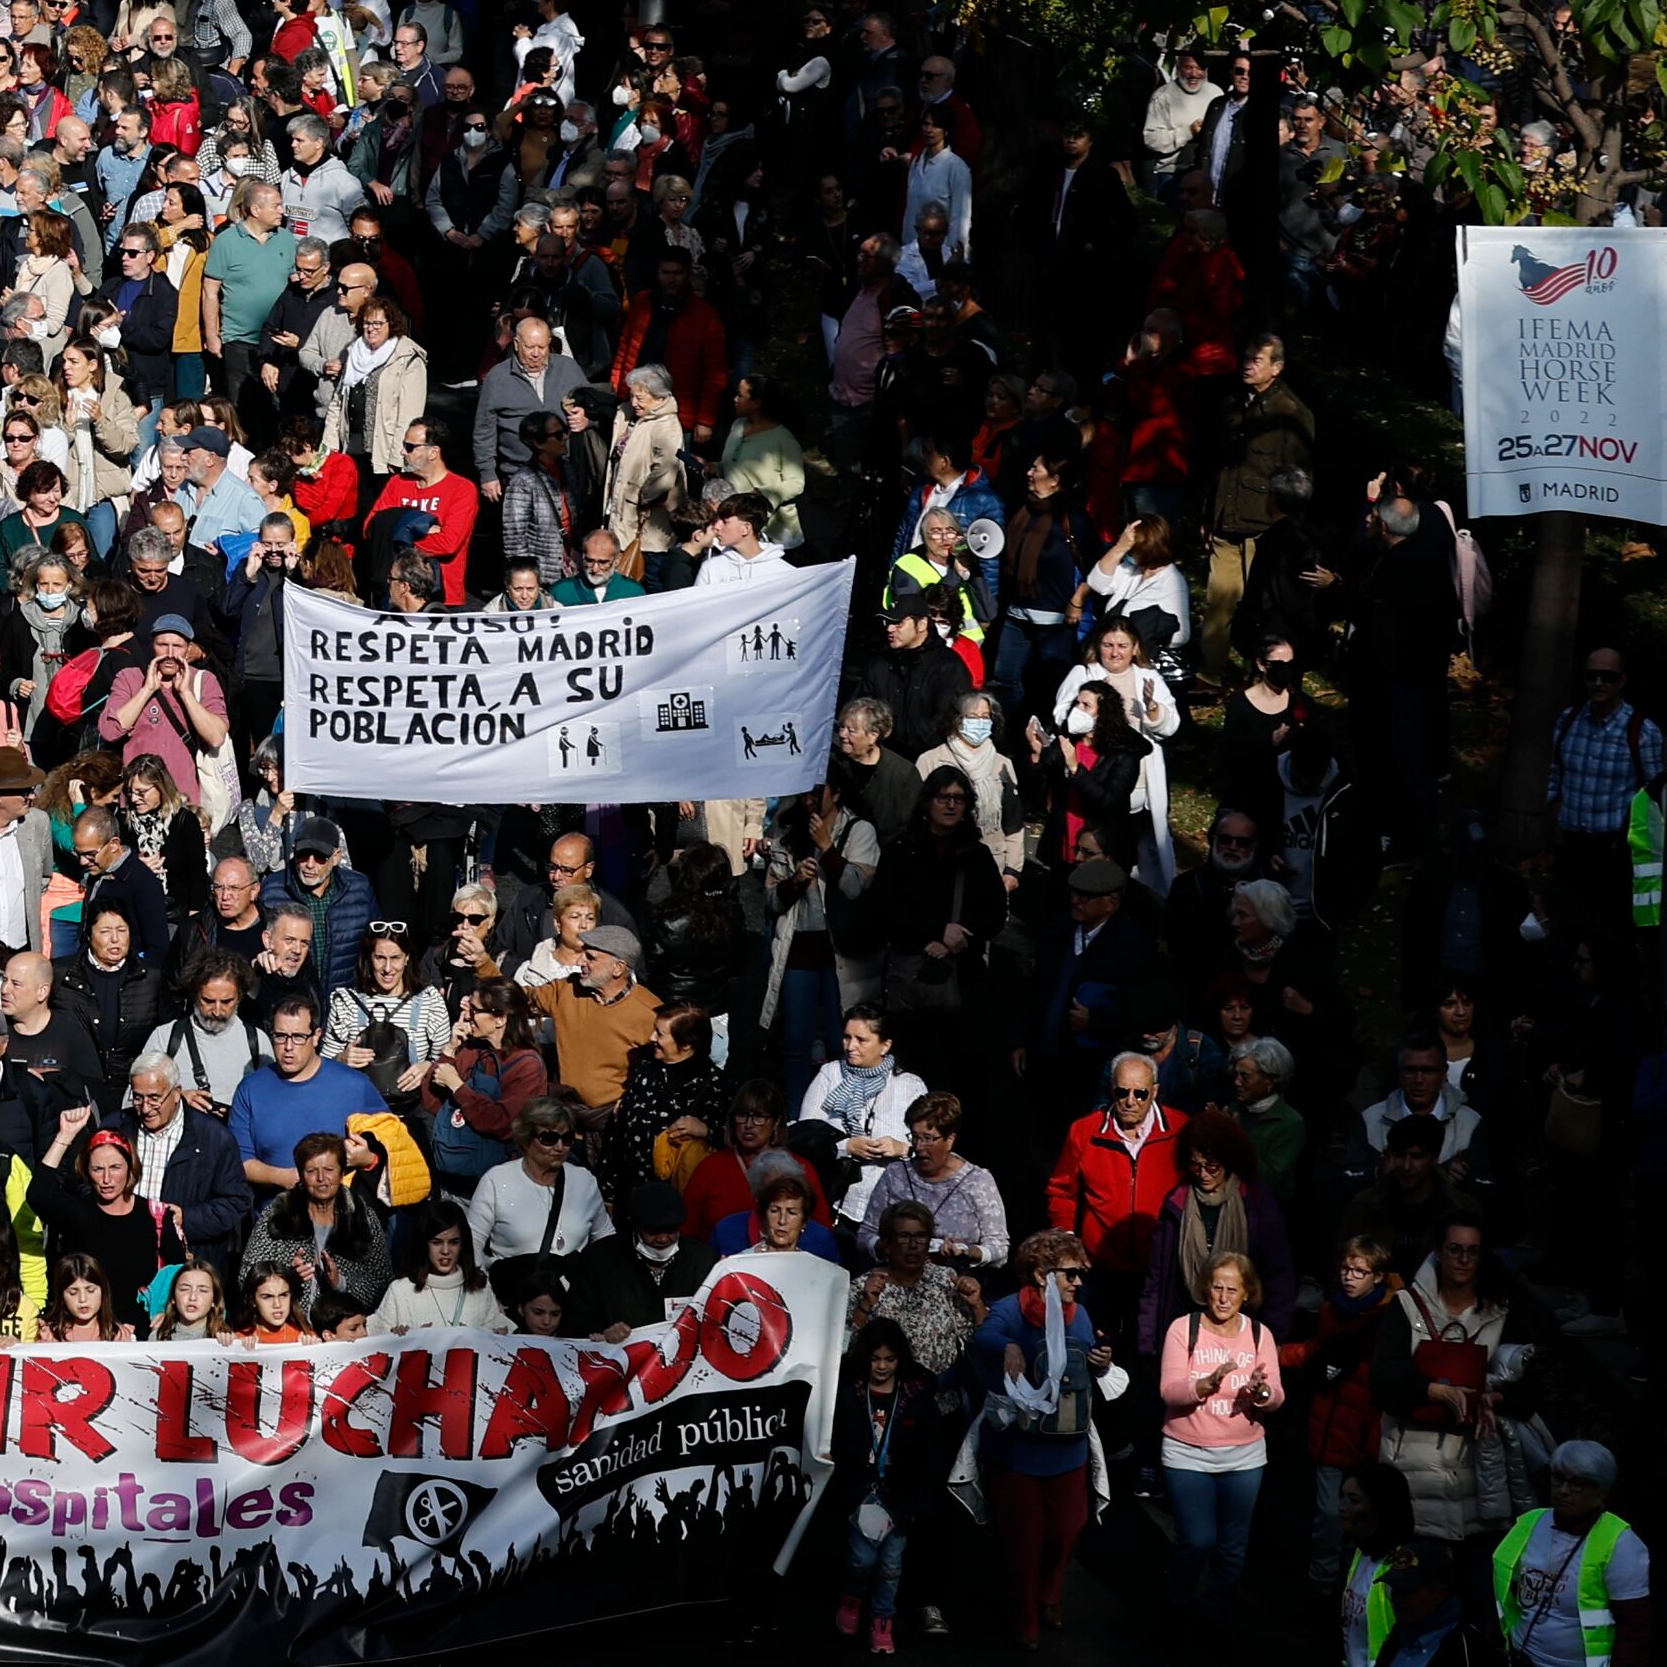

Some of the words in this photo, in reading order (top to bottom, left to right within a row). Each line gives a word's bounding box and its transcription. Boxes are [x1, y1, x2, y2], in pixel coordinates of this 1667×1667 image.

[1585, 246, 1618, 285] 10
[1518, 318, 1615, 342] IFEMA
[1519, 341, 1616, 361] MADRID
[1519, 359, 1617, 383] HORSE
[1521, 381, 1617, 406] WEEK
[401, 496, 441, 513] TAKE
[1543, 483, 1620, 503] MADRID
[310, 630, 491, 665] RESPETA
[310, 673, 487, 709] RESPETA
[511, 672, 542, 706] A
[567, 665, 624, 704] SU
[310, 703, 527, 746] POBLACIÓN
[1194, 1348, 1231, 1365] THINK
[1237, 1352, 1255, 1368] OF
[555, 1421, 663, 1495] sanidad
